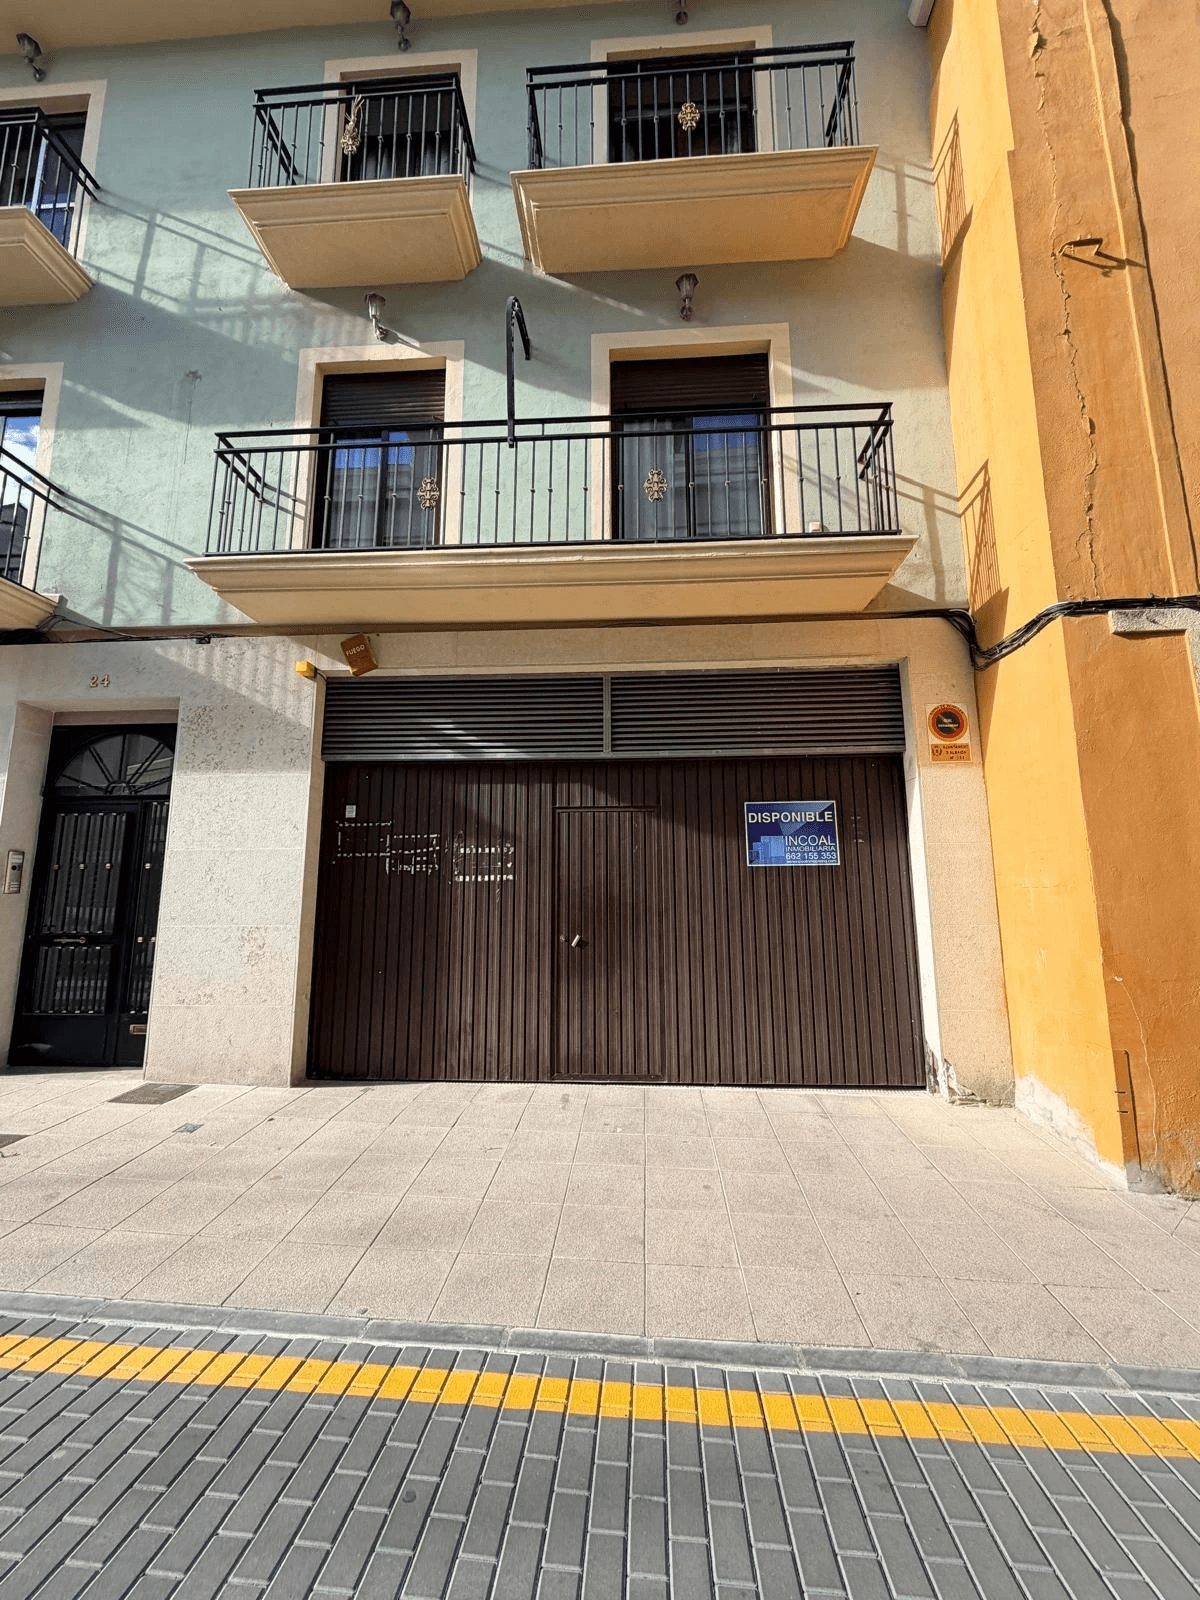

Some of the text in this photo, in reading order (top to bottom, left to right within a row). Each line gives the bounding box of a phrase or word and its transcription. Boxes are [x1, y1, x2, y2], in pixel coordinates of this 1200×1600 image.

[346, 644, 365, 656] FUEGO
[89, 673, 110, 688] 24
[748, 811, 833, 823] DISPONIBLE
[785, 835, 836, 846] INCOAL
[785, 845, 836, 853] INMOBILIARIA
[785, 851, 837, 860] 662 155 353
